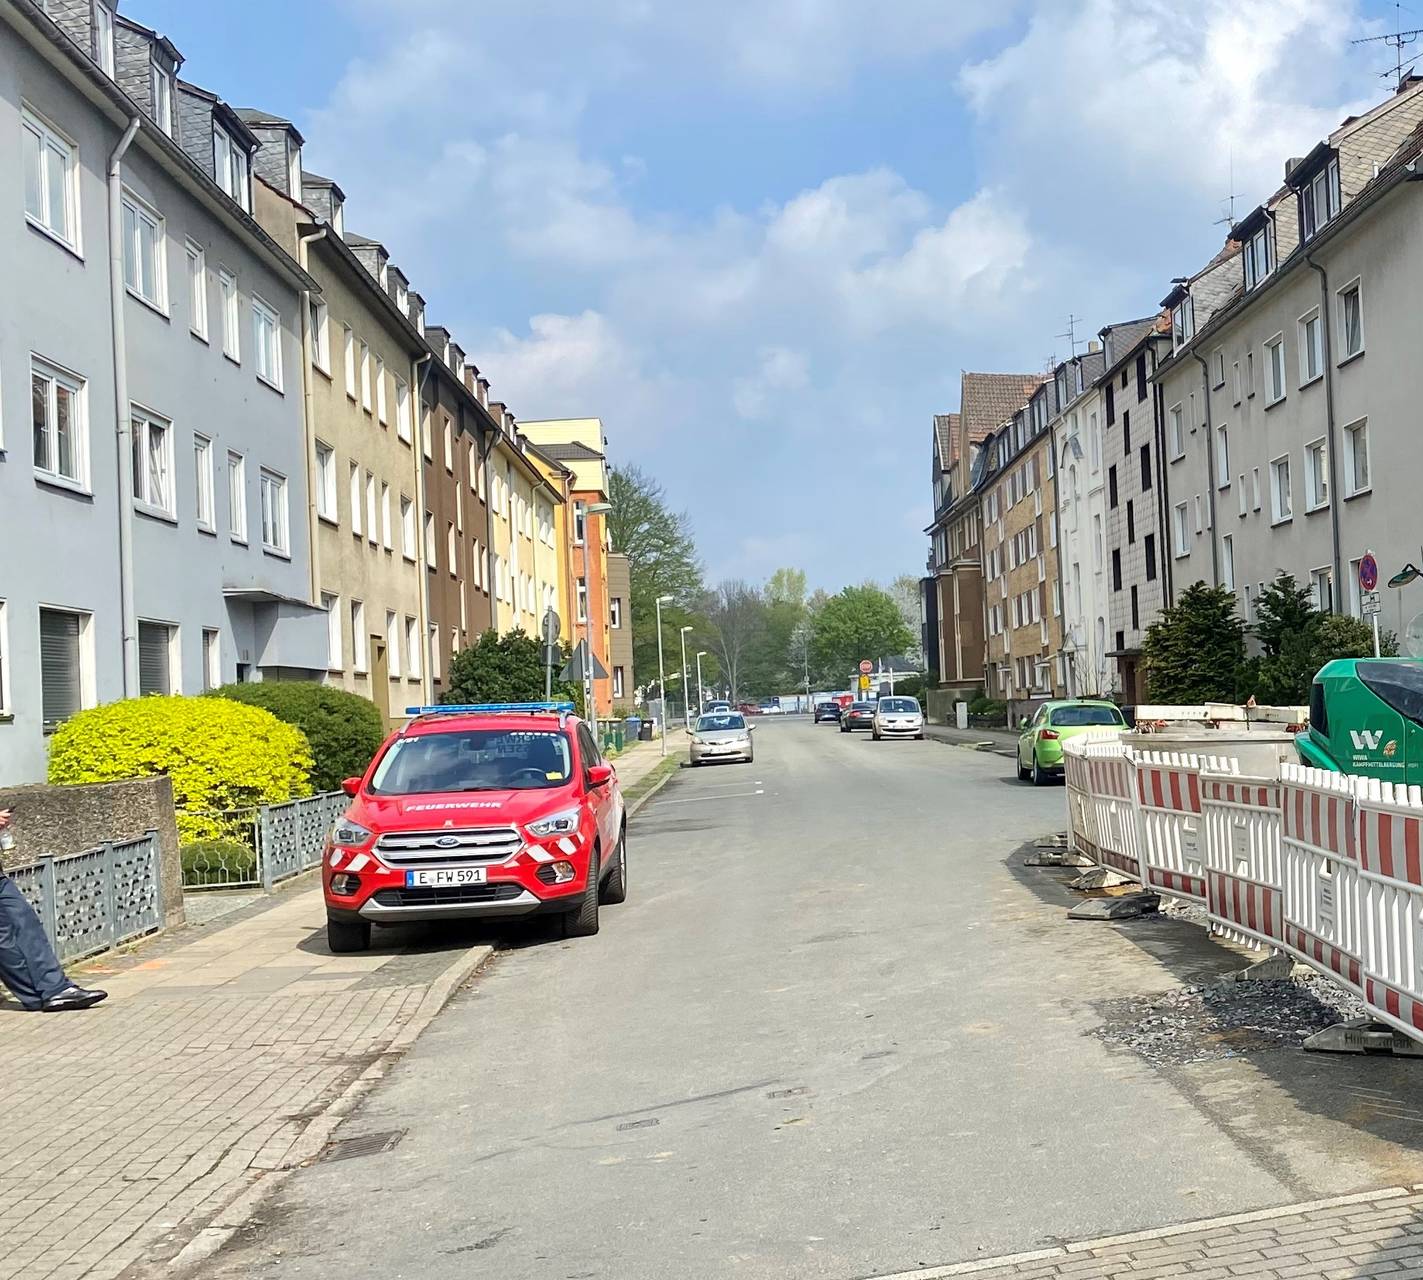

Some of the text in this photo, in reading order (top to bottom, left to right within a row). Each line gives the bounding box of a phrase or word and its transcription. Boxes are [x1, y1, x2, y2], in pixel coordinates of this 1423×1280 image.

[405, 802, 502, 811] FEUERWEHR
[419, 869, 482, 884] E FW 591
